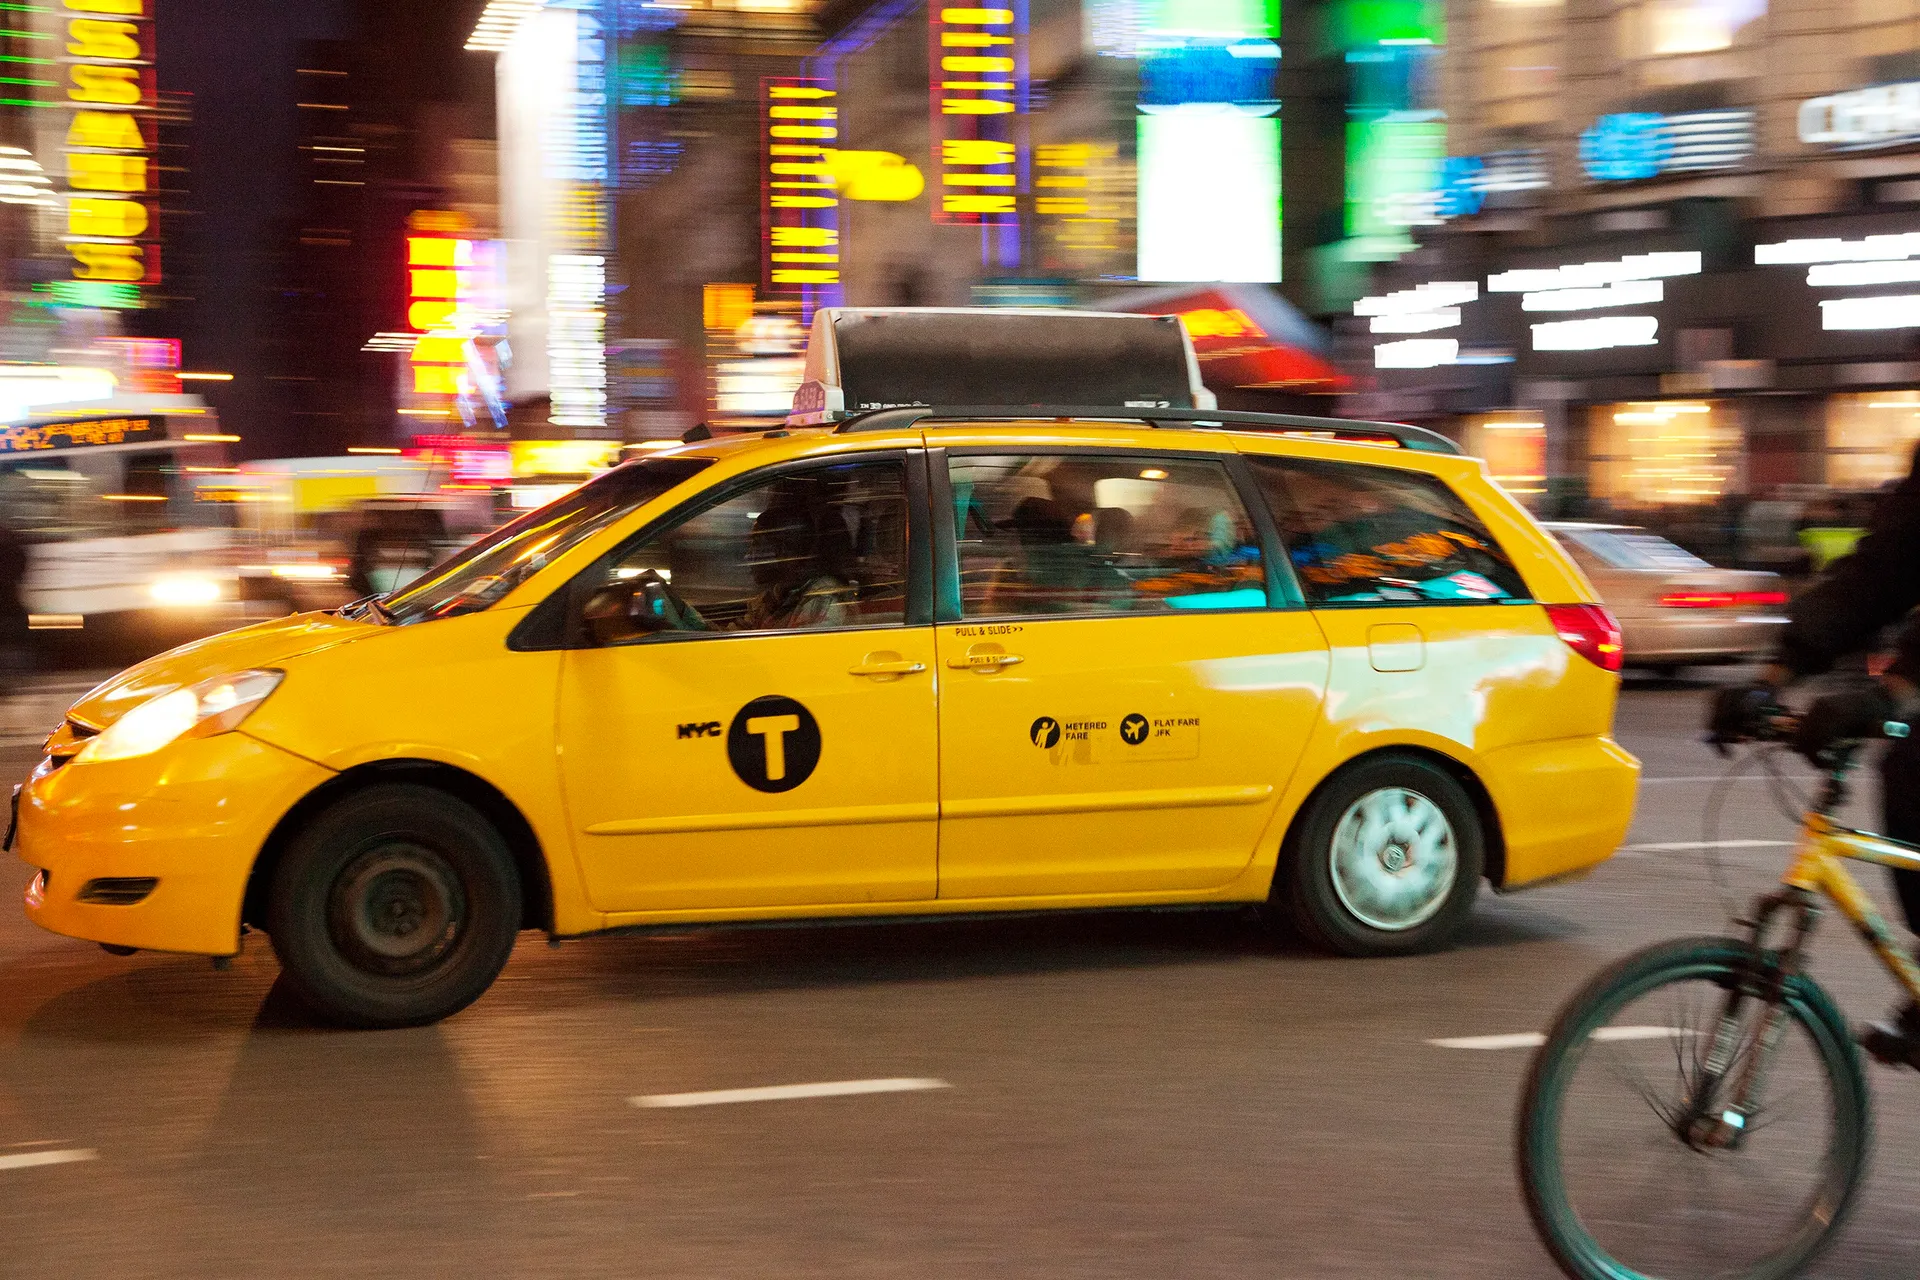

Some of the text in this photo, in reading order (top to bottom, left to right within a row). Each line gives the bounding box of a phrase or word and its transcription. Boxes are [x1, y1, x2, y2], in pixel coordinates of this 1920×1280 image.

[956, 627, 976, 636] PULL
[980, 626, 985, 636] &
[1065, 721, 1107, 731] METERED
[1154, 718, 1200, 727] FLAT FARE
[677, 721, 722, 740] NYC
[1065, 731, 1088, 740] FARE
[1154, 729, 1171, 737] JFK
[746, 714, 800, 781] T
